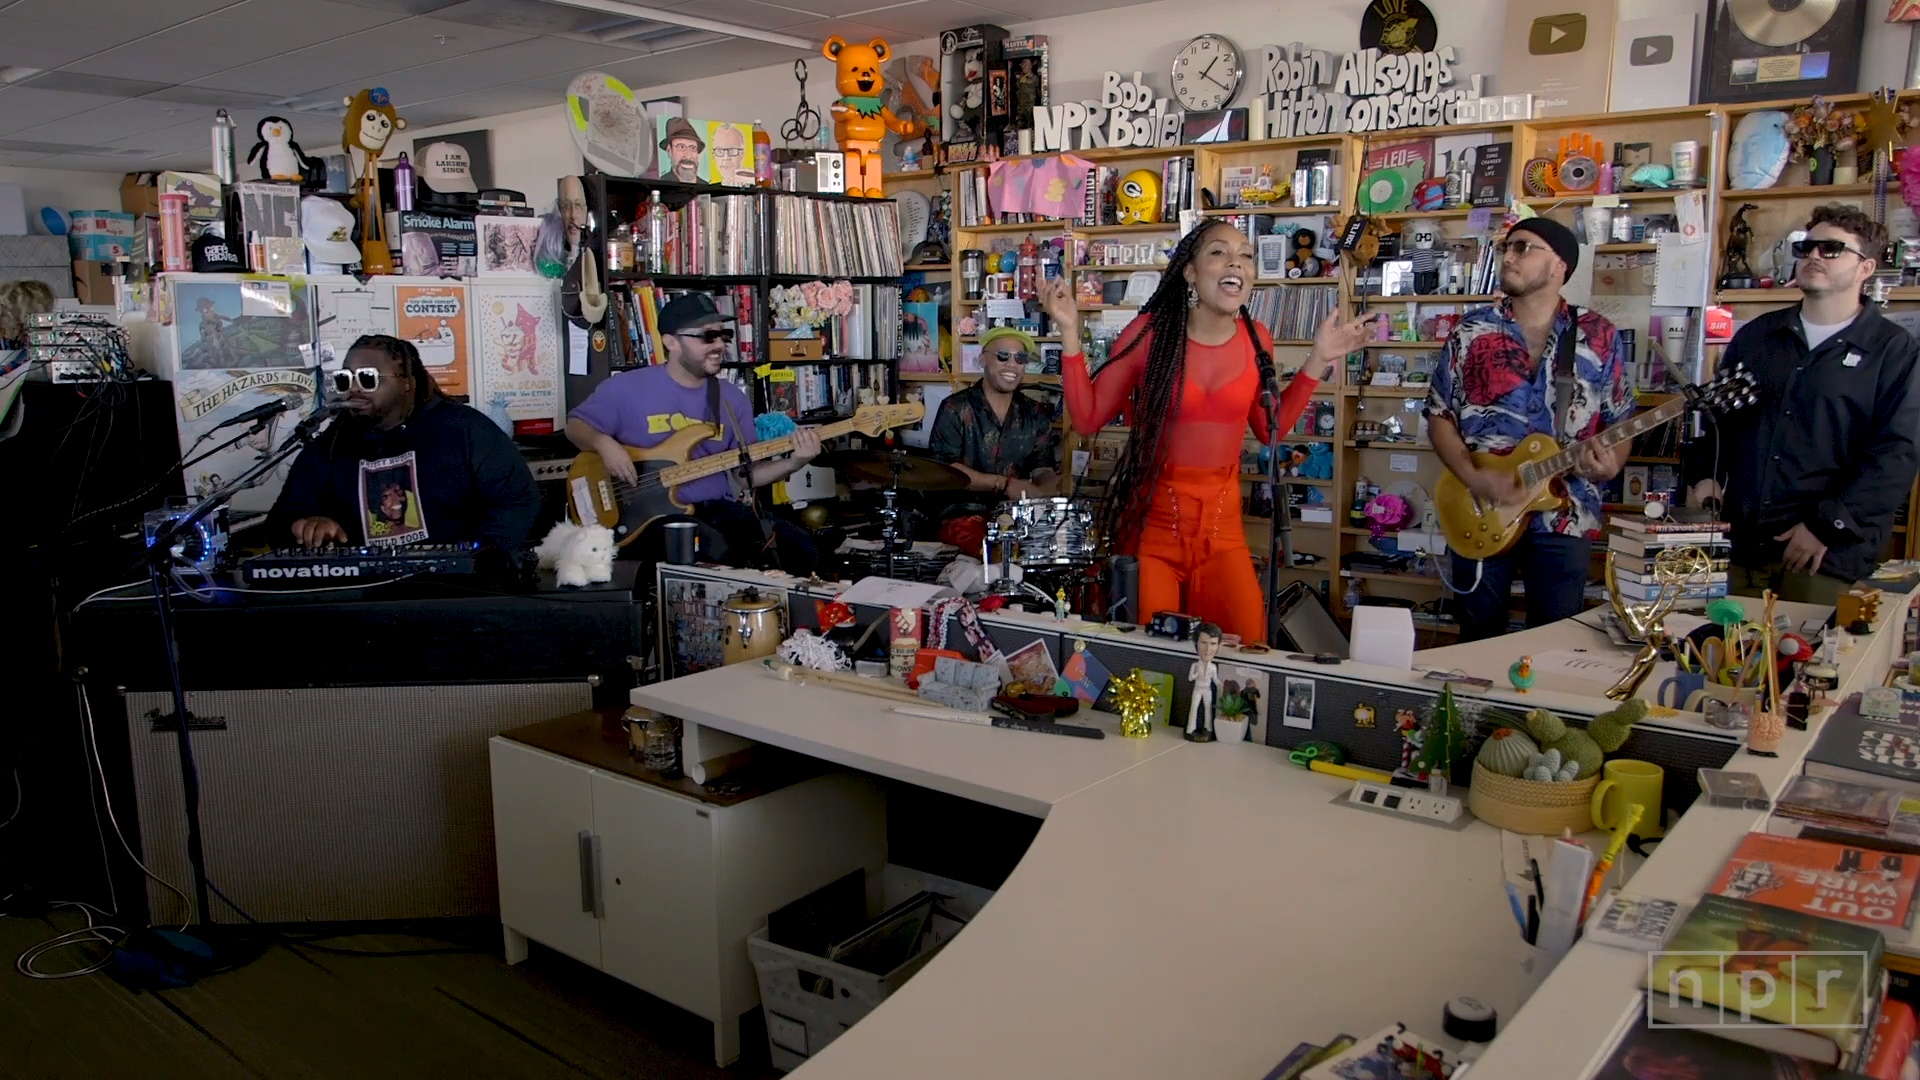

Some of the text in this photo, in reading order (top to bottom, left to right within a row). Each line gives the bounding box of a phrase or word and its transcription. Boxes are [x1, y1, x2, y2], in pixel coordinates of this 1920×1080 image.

[1191, 47, 1197, 55] 11
[1202, 42, 1210, 50] 12
[1224, 54, 1231, 62] 2
[1227, 68, 1234, 77] 3
[1261, 43, 1331, 96] Robin
[1334, 46, 1456, 103] Allsongs
[1177, 73, 1184, 81] 9
[1102, 71, 1152, 112] Bob
[1180, 87, 1187, 95] 8
[1189, 97, 1196, 105] 7
[1202, 100, 1209, 108] 6
[1214, 95, 1221, 103] 5
[1264, 87, 1340, 138] Hilton
[1033, 99, 1110, 152] NPR
[403, 214, 475, 230] Smoke Alarm
[112, 246, 119, 254] 5
[204, 243, 229, 255] café
[406, 304, 458, 314] CONTEST
[493, 380, 552, 390] DAN DEACON
[193, 393, 220, 417] THE
[221, 372, 280, 400] HAZARDS
[290, 372, 314, 388] LOVE
[252, 564, 360, 579] novation
[1794, 870, 1898, 898] WIRE
[1815, 888, 1897, 907] ON THE
[1802, 897, 1894, 920] OUT
